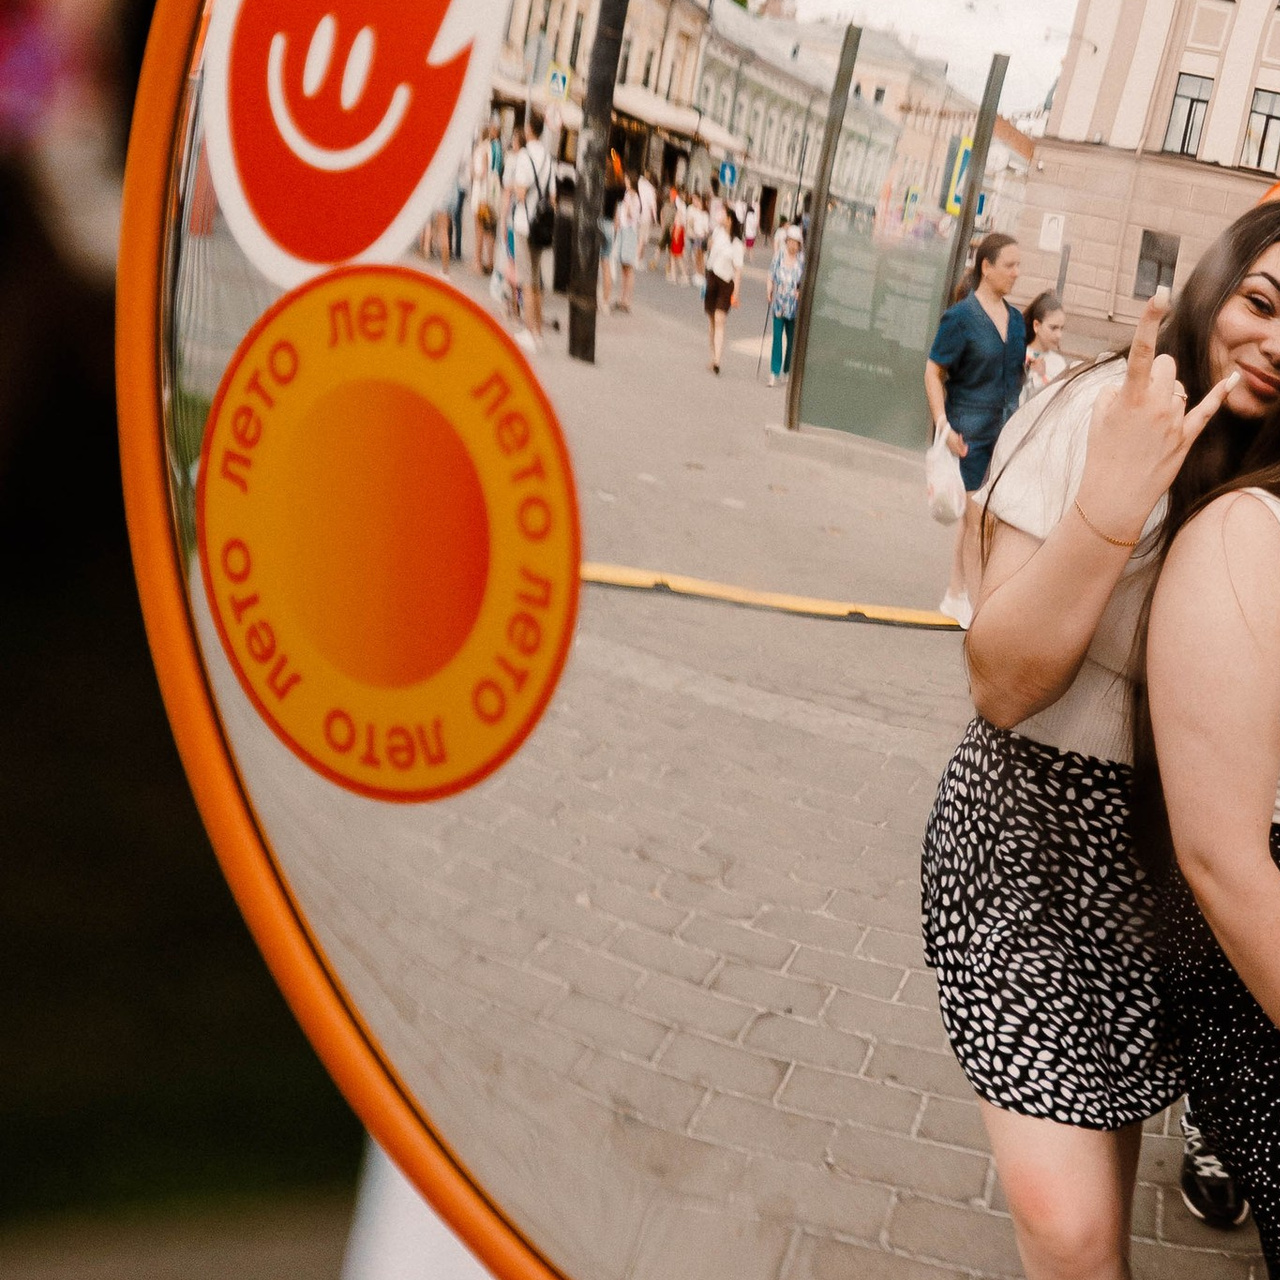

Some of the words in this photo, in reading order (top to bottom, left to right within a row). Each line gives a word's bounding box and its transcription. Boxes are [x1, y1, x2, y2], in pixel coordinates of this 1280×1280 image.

[327, 295, 454, 361] лето
[220, 339, 301, 495] лето
[471, 370, 554, 544] лето
[220, 537, 303, 703] лето
[470, 566, 555, 728] лето
[322, 706, 450, 774] лето
